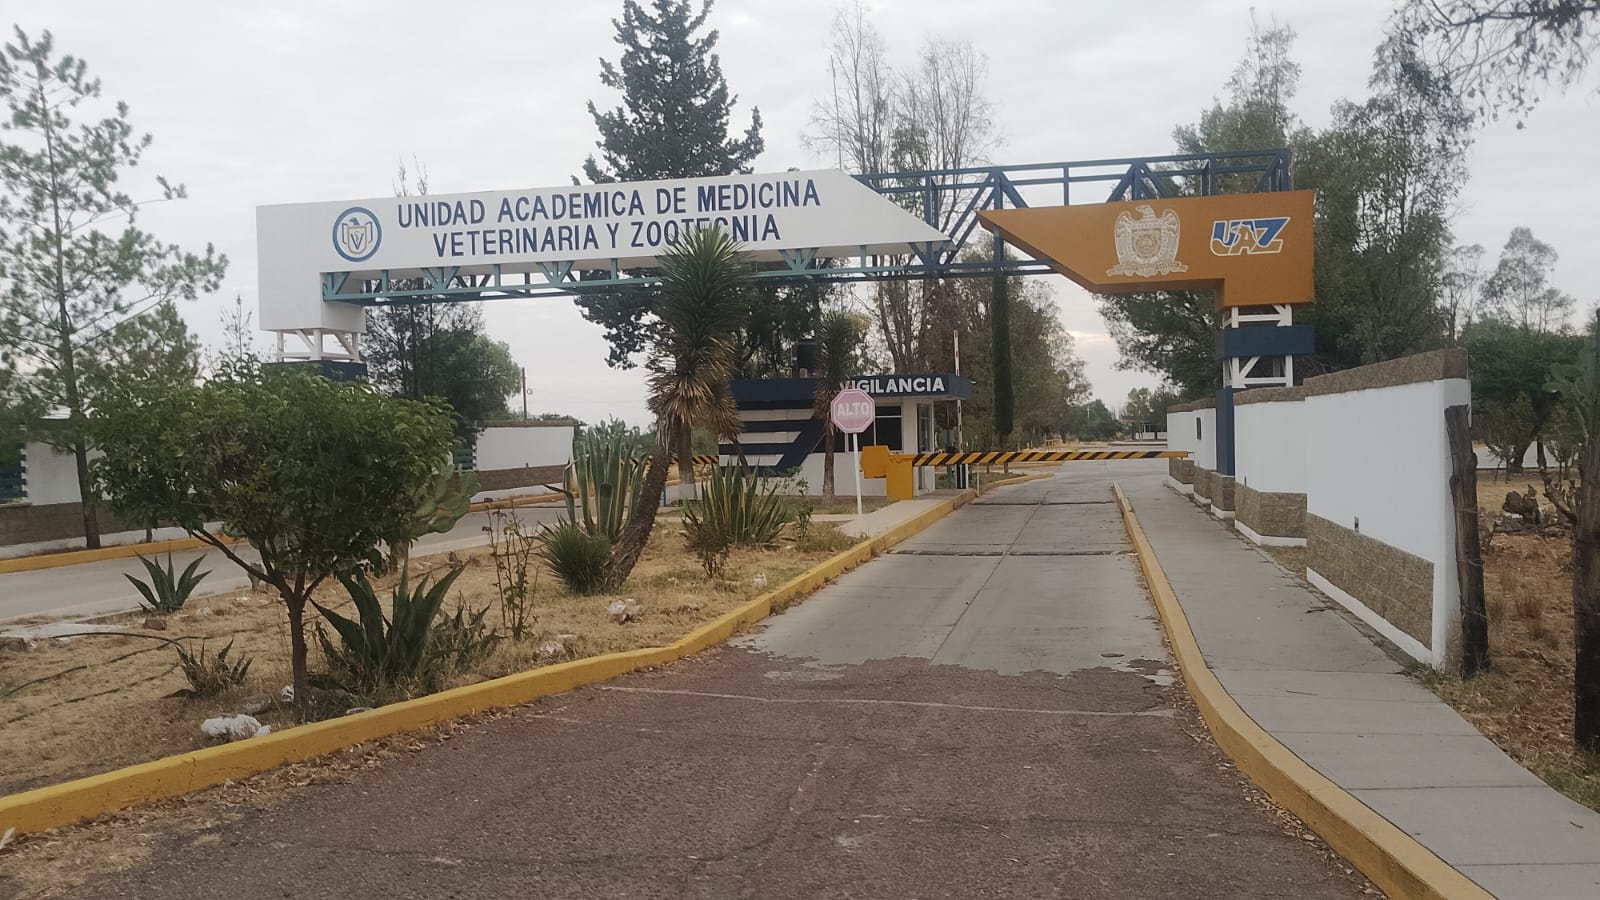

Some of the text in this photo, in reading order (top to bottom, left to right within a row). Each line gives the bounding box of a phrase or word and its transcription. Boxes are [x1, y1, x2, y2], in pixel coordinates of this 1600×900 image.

[398, 179, 821, 228] UNIDAD ACADEMICA DE MEDICINA
[433, 223, 600, 258] VETERINARIA
[606, 222, 620, 249] Y
[1210, 216, 1291, 256] UAZ
[837, 401, 870, 417] ALTO
